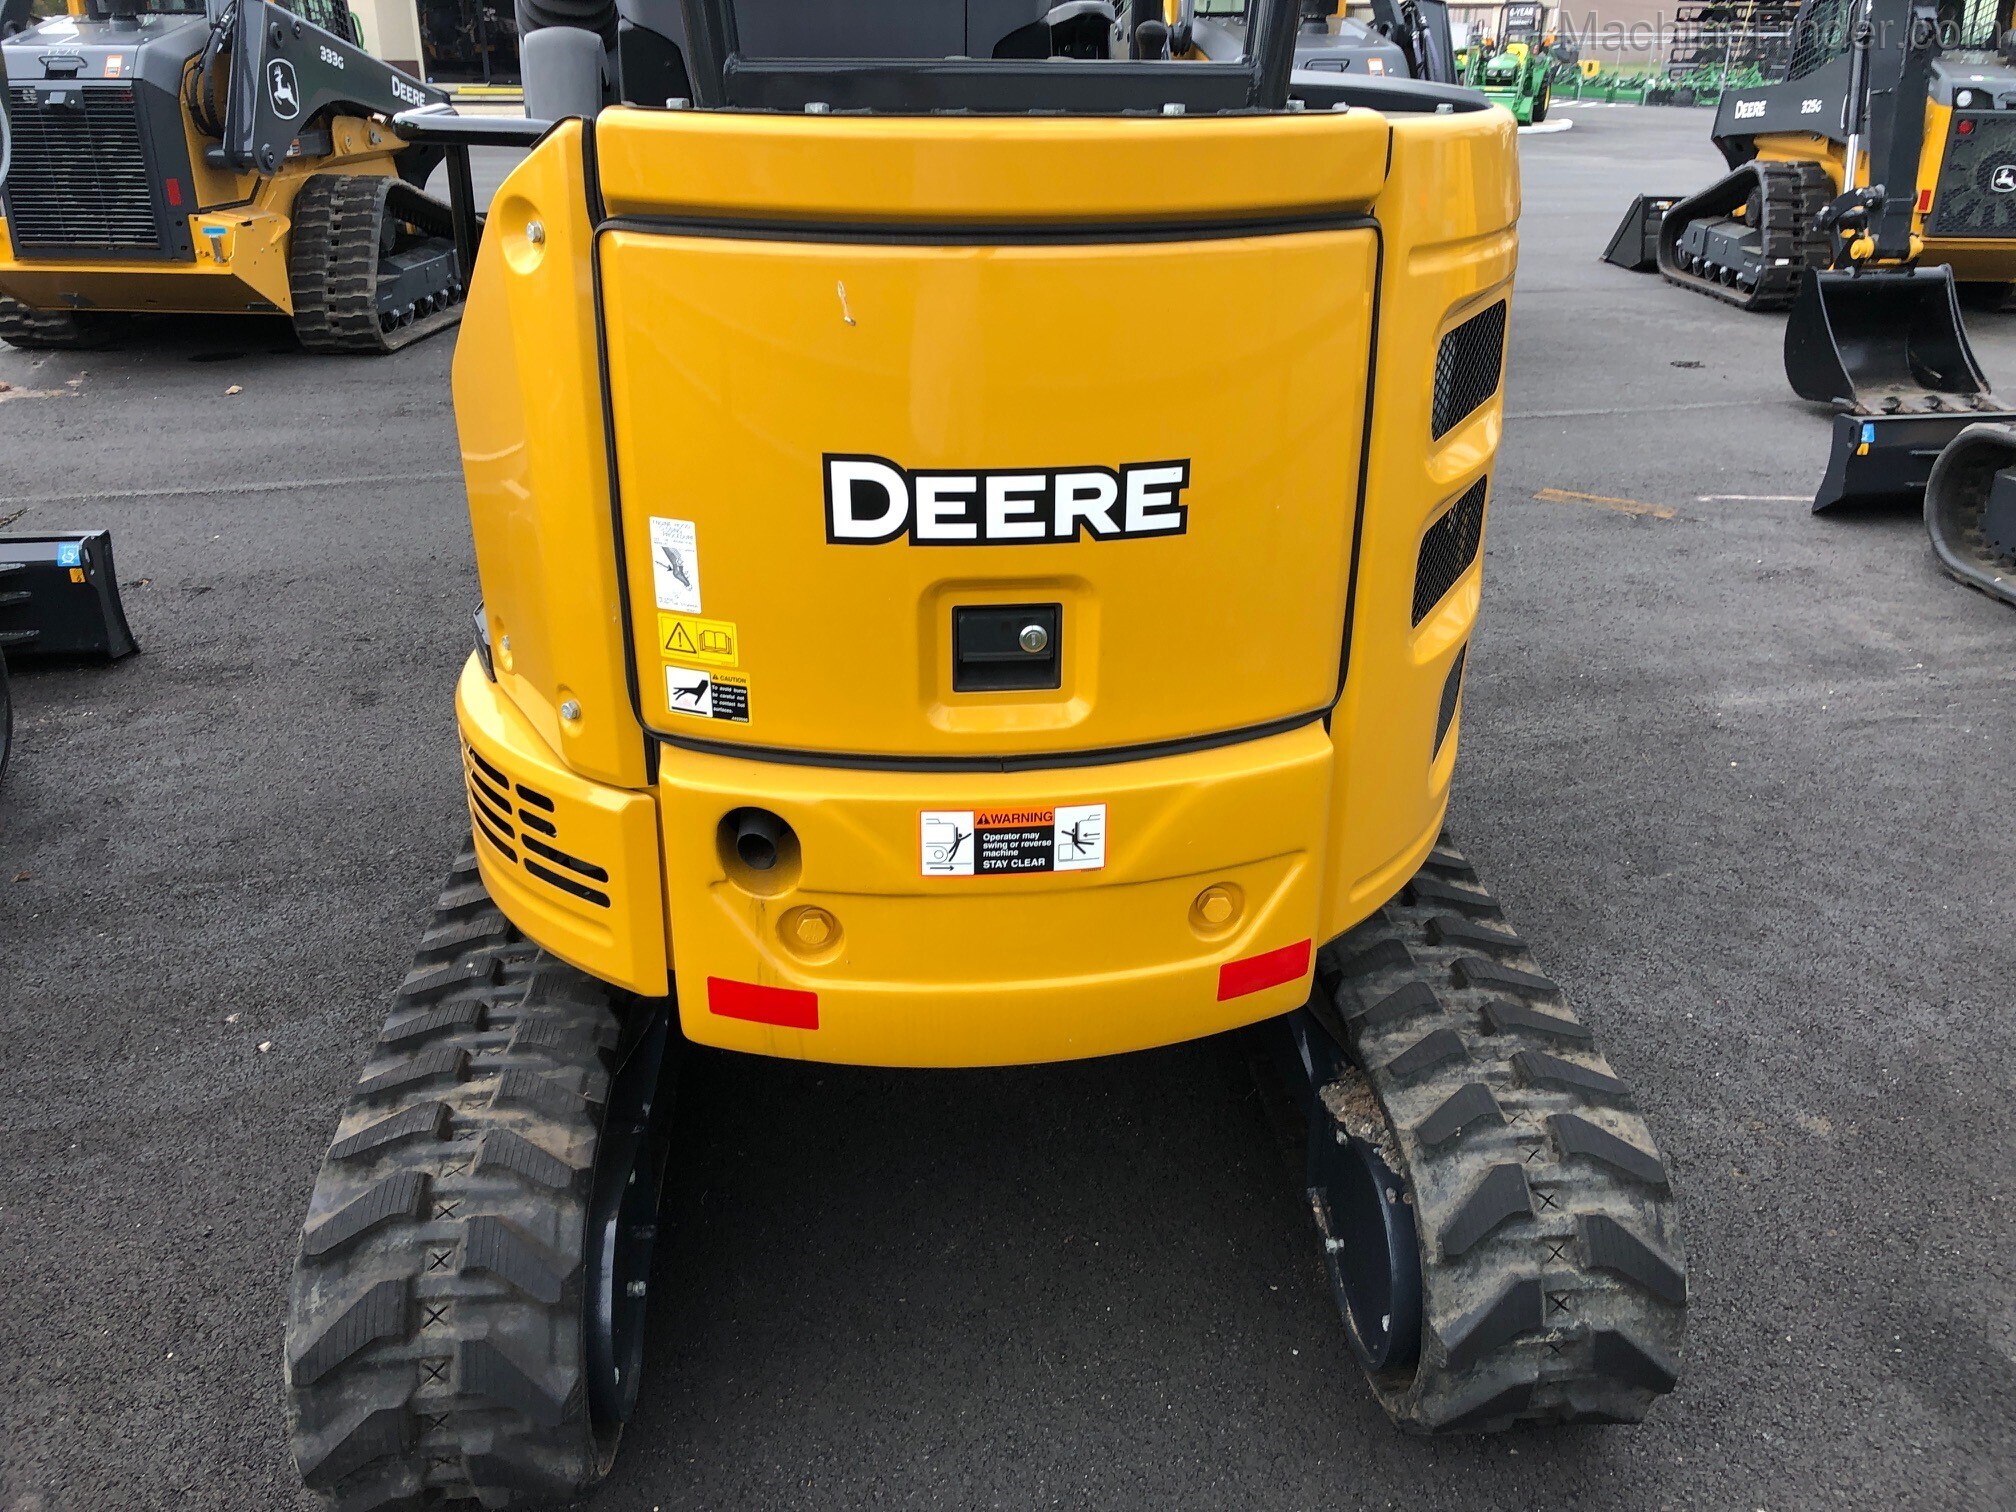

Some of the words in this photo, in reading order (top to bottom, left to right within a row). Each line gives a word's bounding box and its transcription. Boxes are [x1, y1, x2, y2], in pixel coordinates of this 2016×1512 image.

[320, 45, 344, 70] 333G
[391, 75, 426, 108] DEERE
[1734, 99, 1767, 119] DEERE
[829, 459, 1184, 540] DEERE
[719, 675, 747, 684] CAUTION
[990, 811, 1053, 825] WARNING
[983, 832, 1020, 842] Operator
[1022, 832, 1040, 841] may
[983, 841, 1008, 851] swing
[1020, 839, 1052, 848] reverse
[983, 850, 1019, 858] machine
[983, 859, 1008, 869] STAY
[1011, 857, 1046, 868] CLEAR
